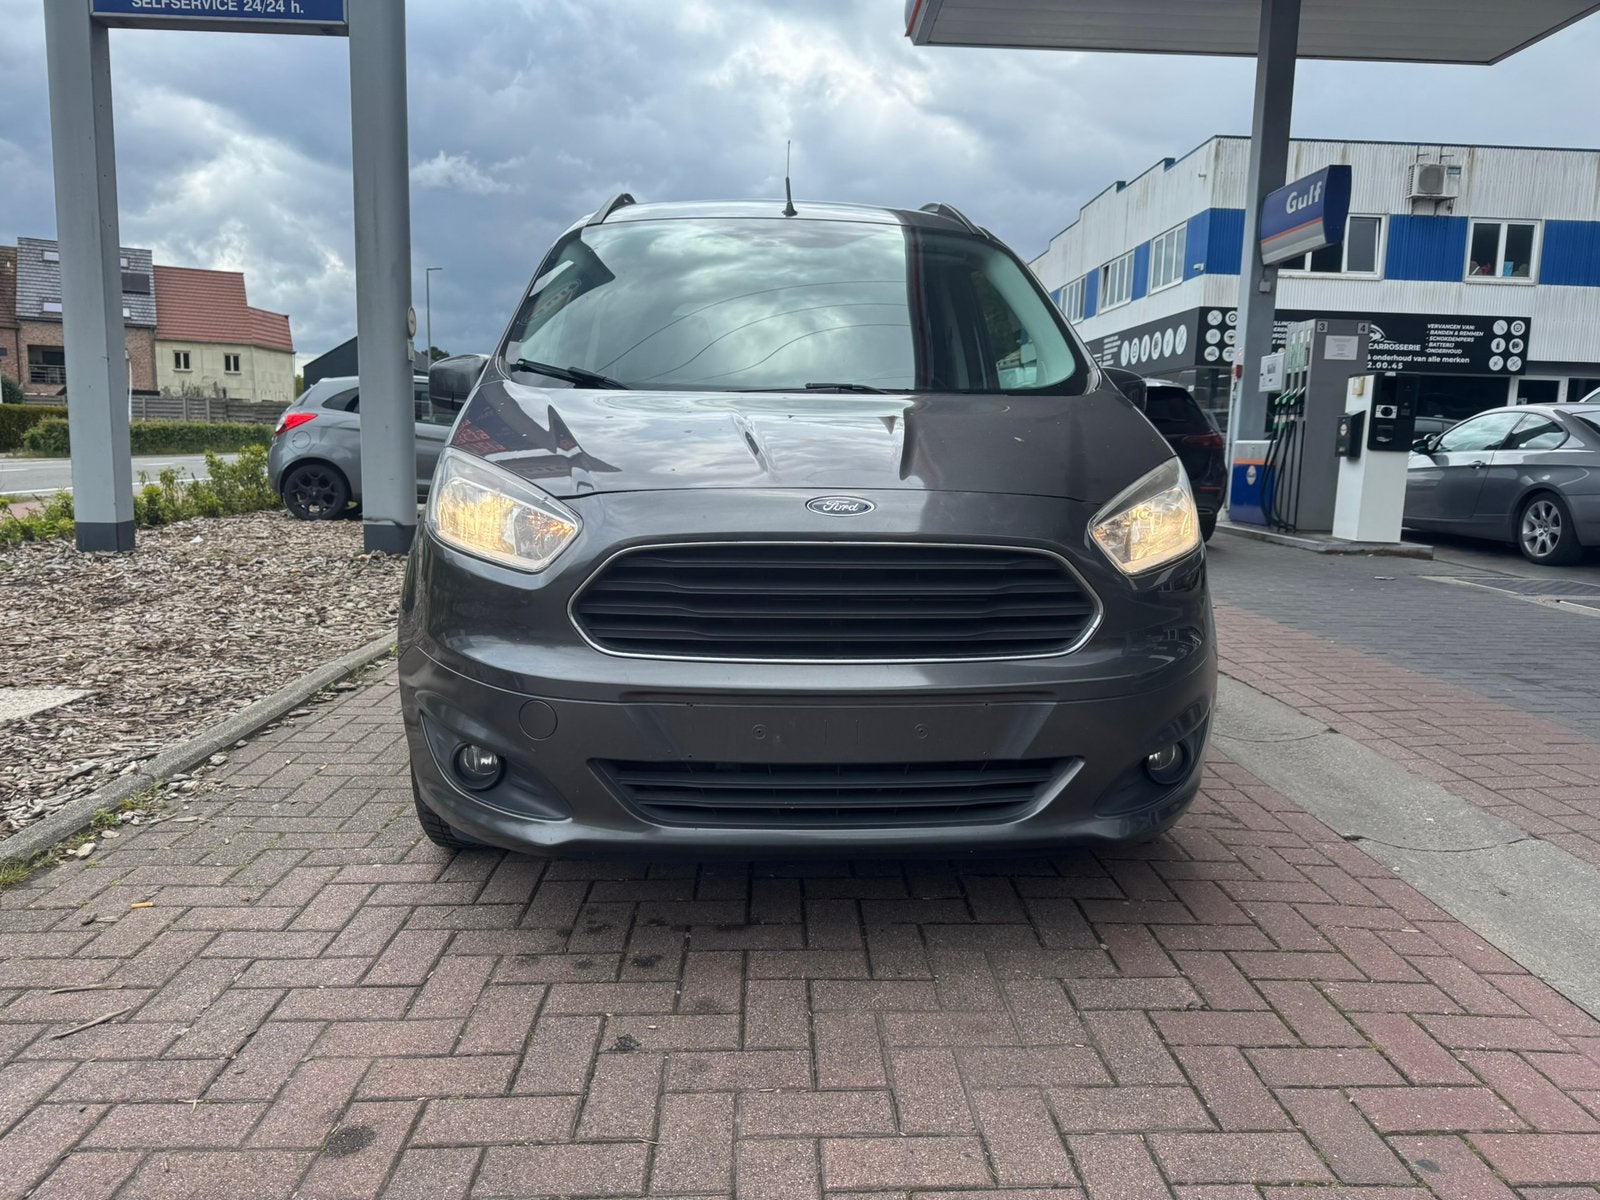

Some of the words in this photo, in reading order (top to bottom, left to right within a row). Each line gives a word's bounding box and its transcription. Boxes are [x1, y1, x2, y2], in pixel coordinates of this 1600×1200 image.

[132, 0, 238, 11] SELFSERVICE
[243, 0, 285, 13] 24/24
[291, 0, 304, 13] h.
[1286, 181, 1322, 214] Gulf
[1319, 323, 1325, 331] 3
[1360, 324, 1366, 332] 4
[1368, 343, 1421, 351] CARROSSERIE
[823, 500, 859, 511] Ford
